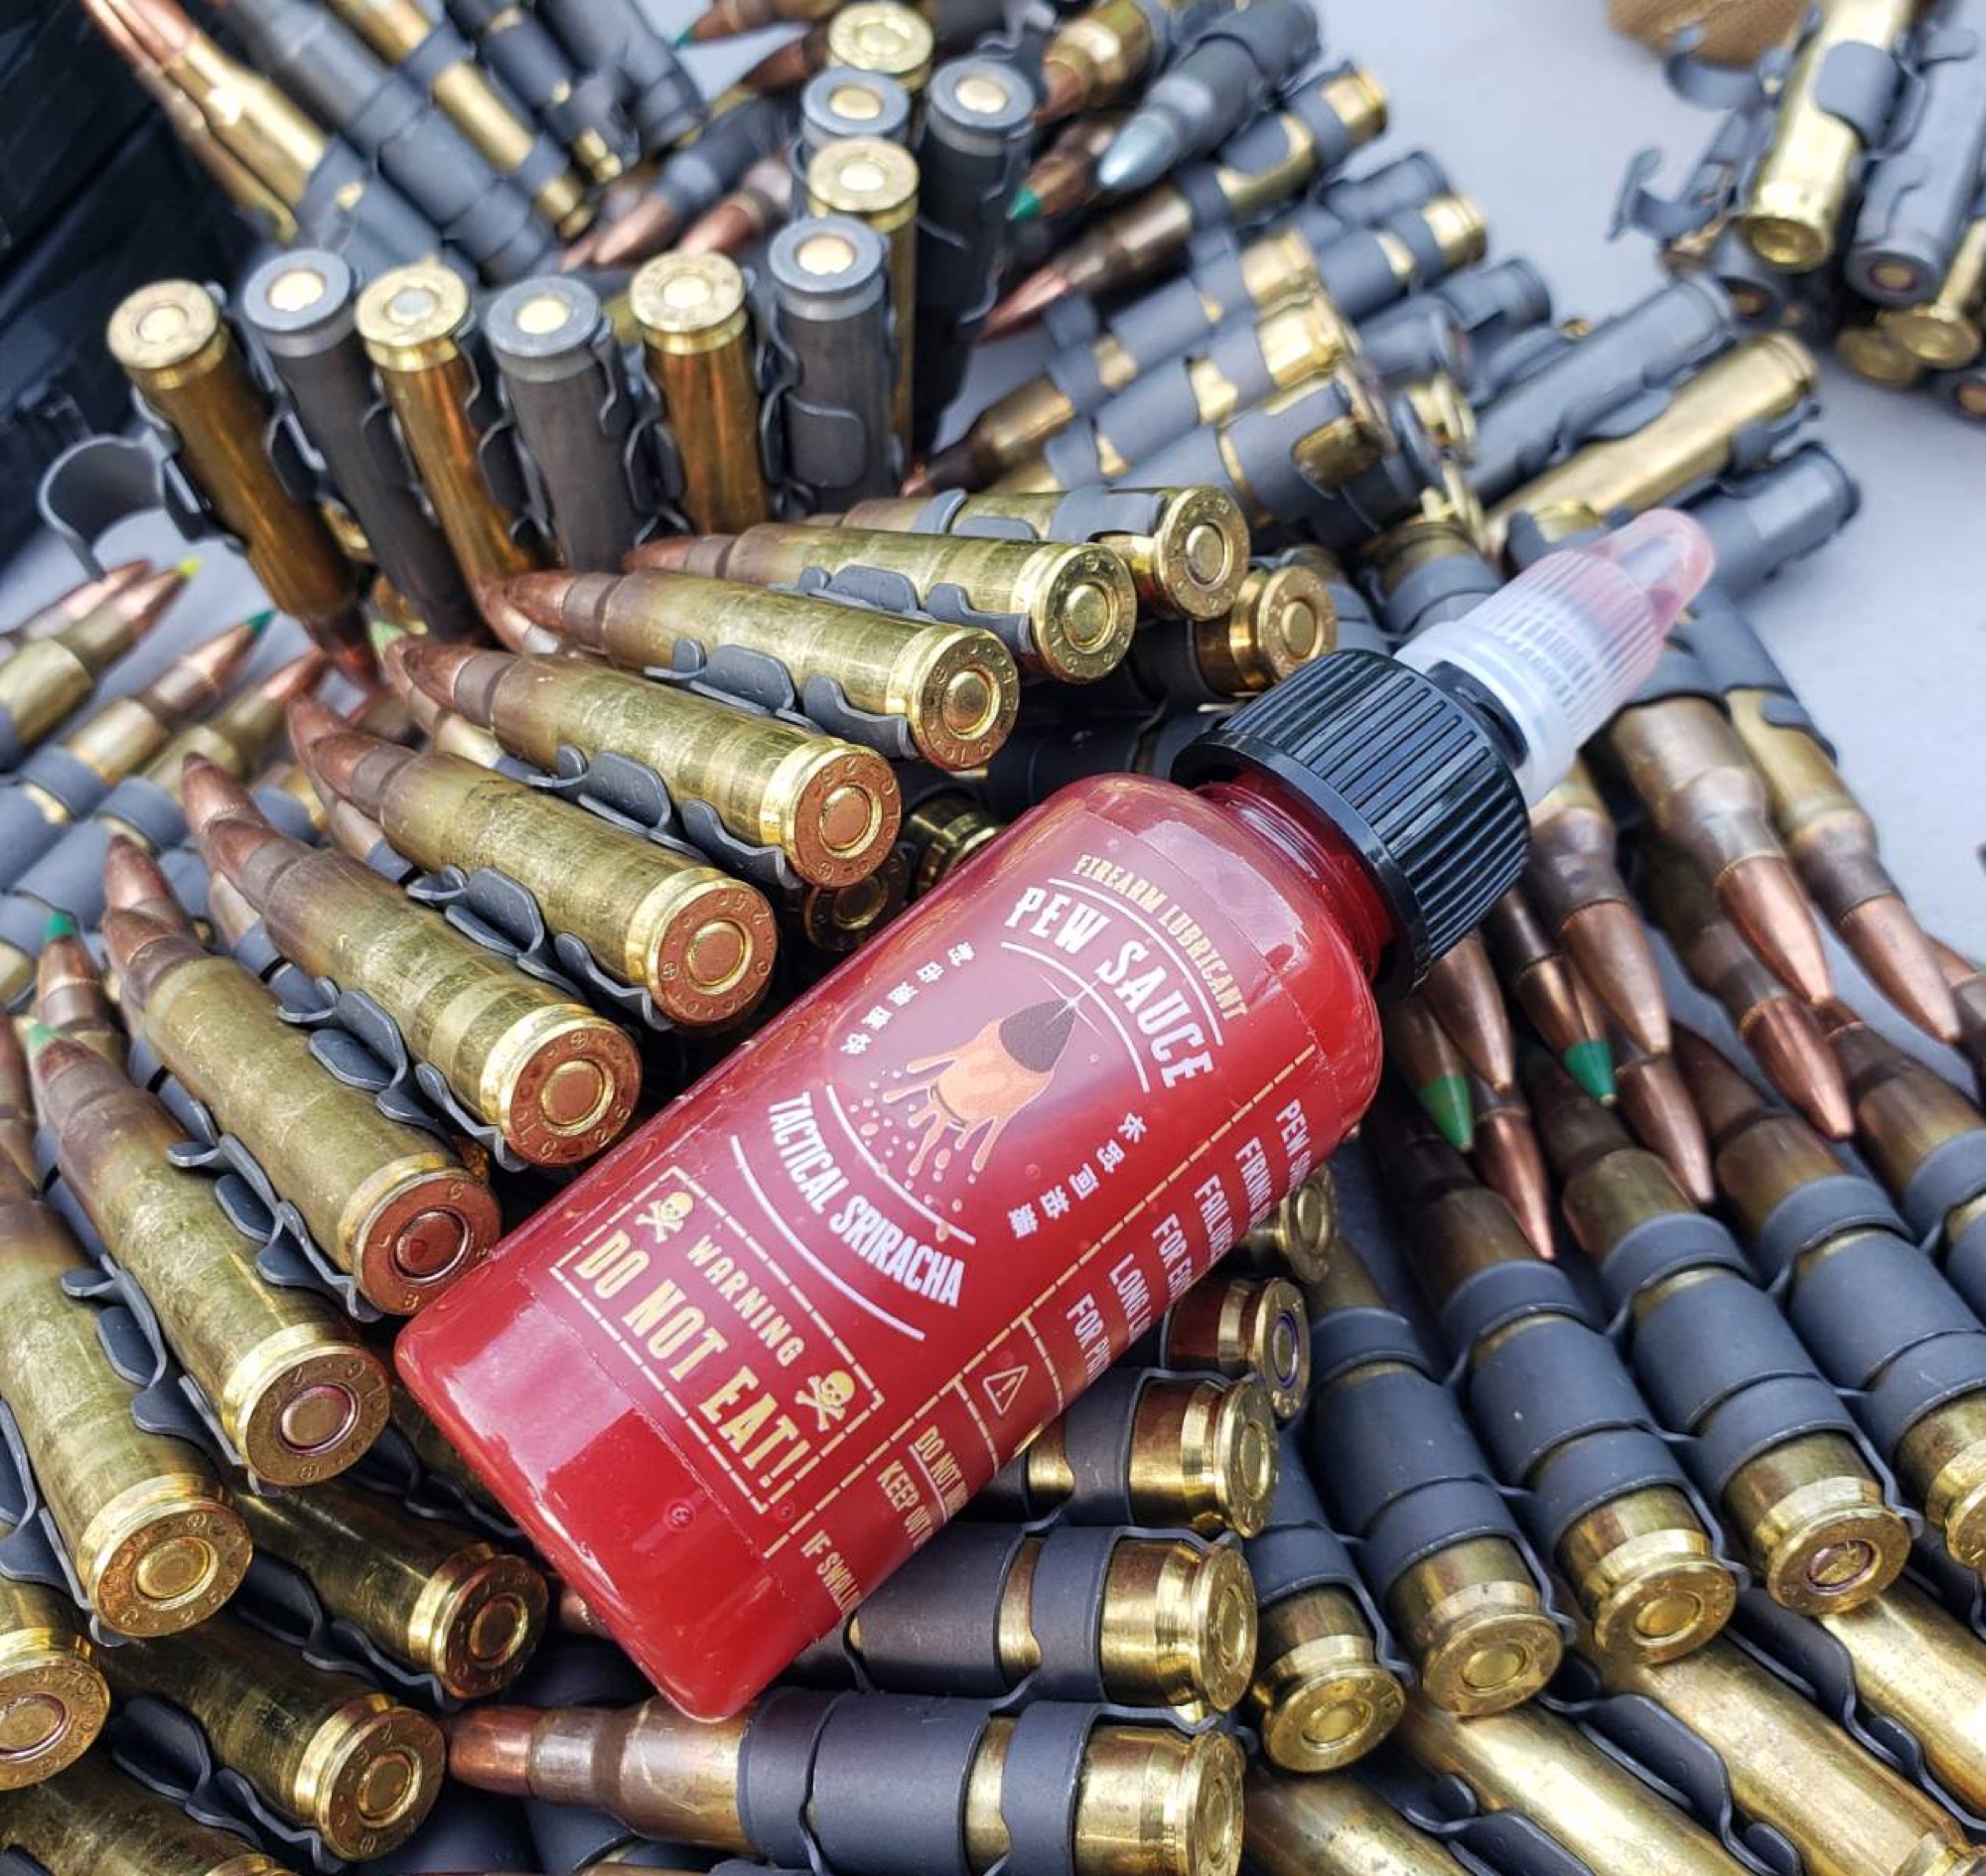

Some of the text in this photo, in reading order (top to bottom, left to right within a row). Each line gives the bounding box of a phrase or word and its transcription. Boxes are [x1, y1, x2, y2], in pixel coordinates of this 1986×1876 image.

[1072, 854, 1248, 1022] FIREARM LUBRICANT
[1004, 887, 1213, 1088] PEW SAUCE
[1275, 1098, 1311, 1158] PEW
[769, 1091, 965, 1308] TACTICAL SRIRACHA
[1152, 1213, 1189, 1269] FOR
[687, 1234, 805, 1368] WARNING
[1108, 1252, 1151, 1327] LONG
[1065, 1293, 1105, 1350] FOR
[573, 1229, 649, 1299] DO
[622, 1278, 728, 1381] NOT
[698, 1366, 811, 1489] EAT!
[914, 1425, 945, 1463] DO
[928, 1451, 963, 1494] NOT
[877, 1459, 921, 1513] KEEP
[800, 1529, 832, 1558] IF
